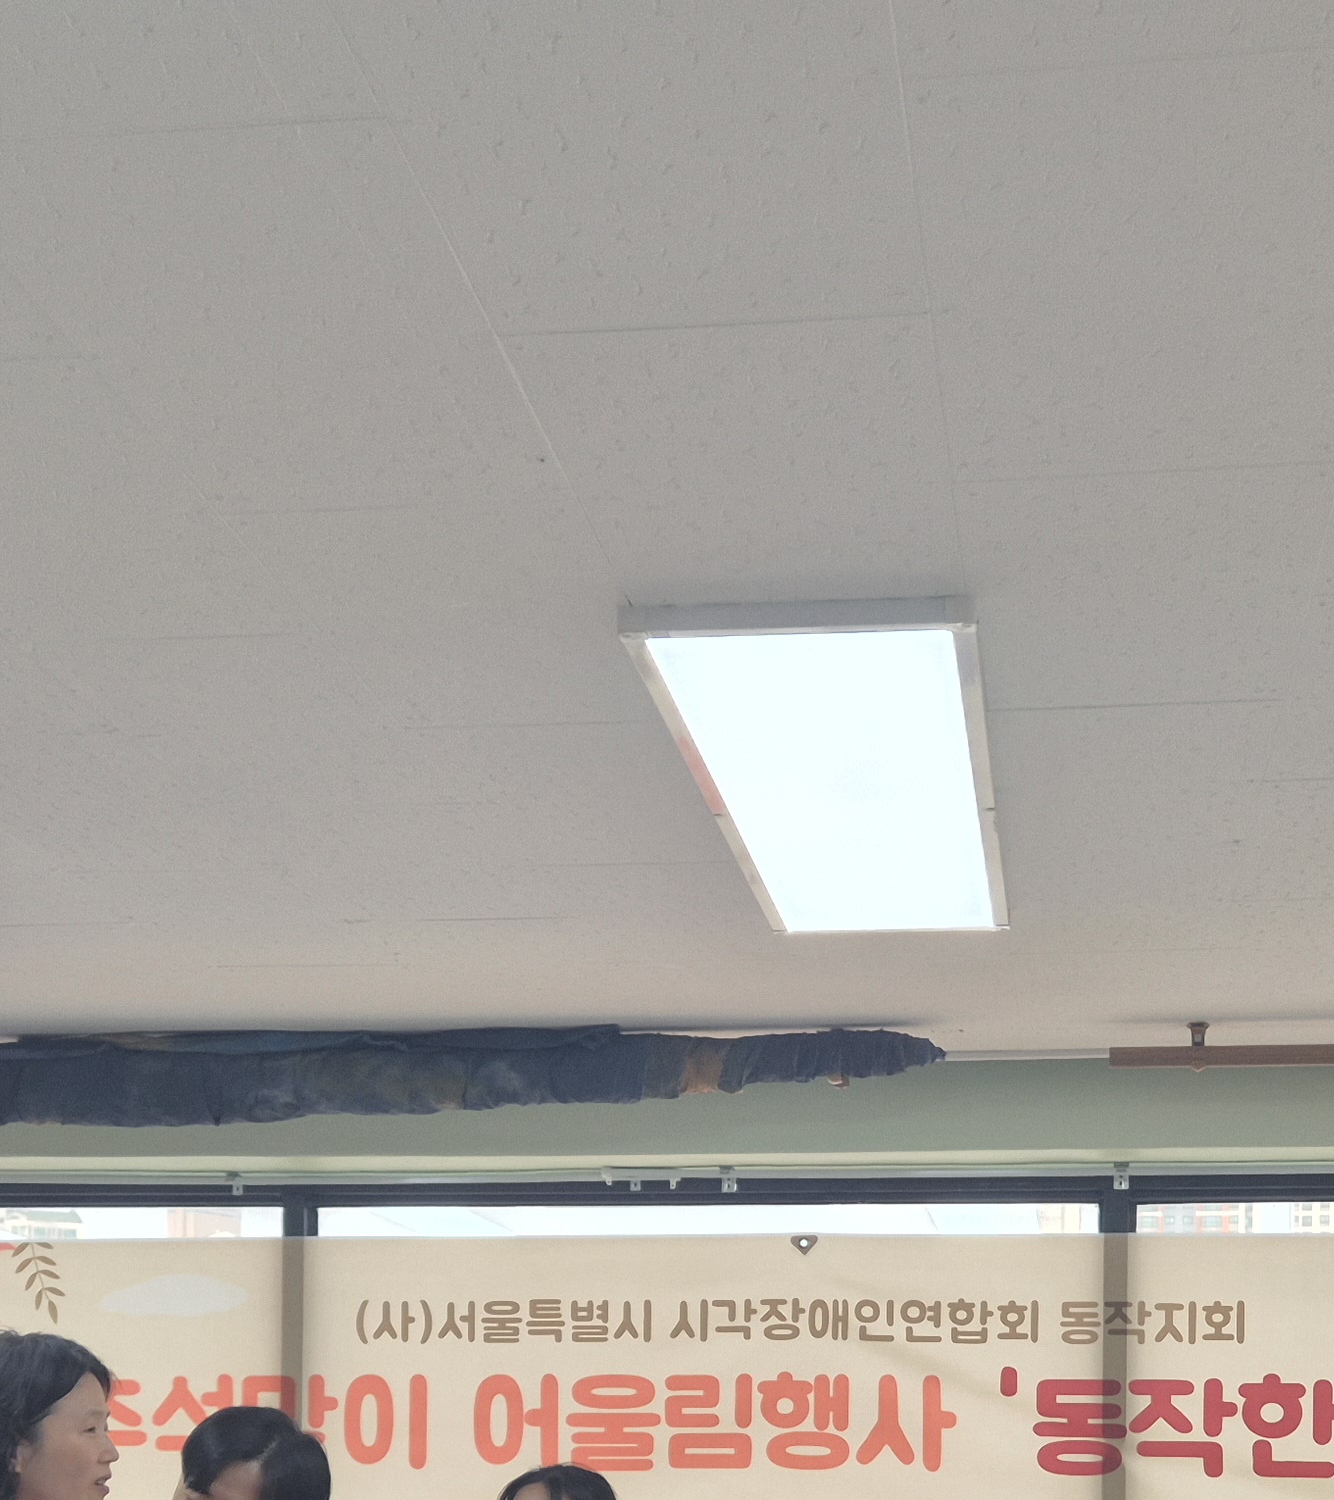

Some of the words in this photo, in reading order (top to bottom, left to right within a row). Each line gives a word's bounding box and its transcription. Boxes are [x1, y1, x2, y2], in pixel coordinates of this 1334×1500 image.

[355, 1298, 653, 1345] (사)서울특별시
[669, 1297, 1039, 1345] 시각장애인연합회
[1059, 1299, 1247, 1345] 동작지회
[473, 1370, 958, 1473] 어울림행사
